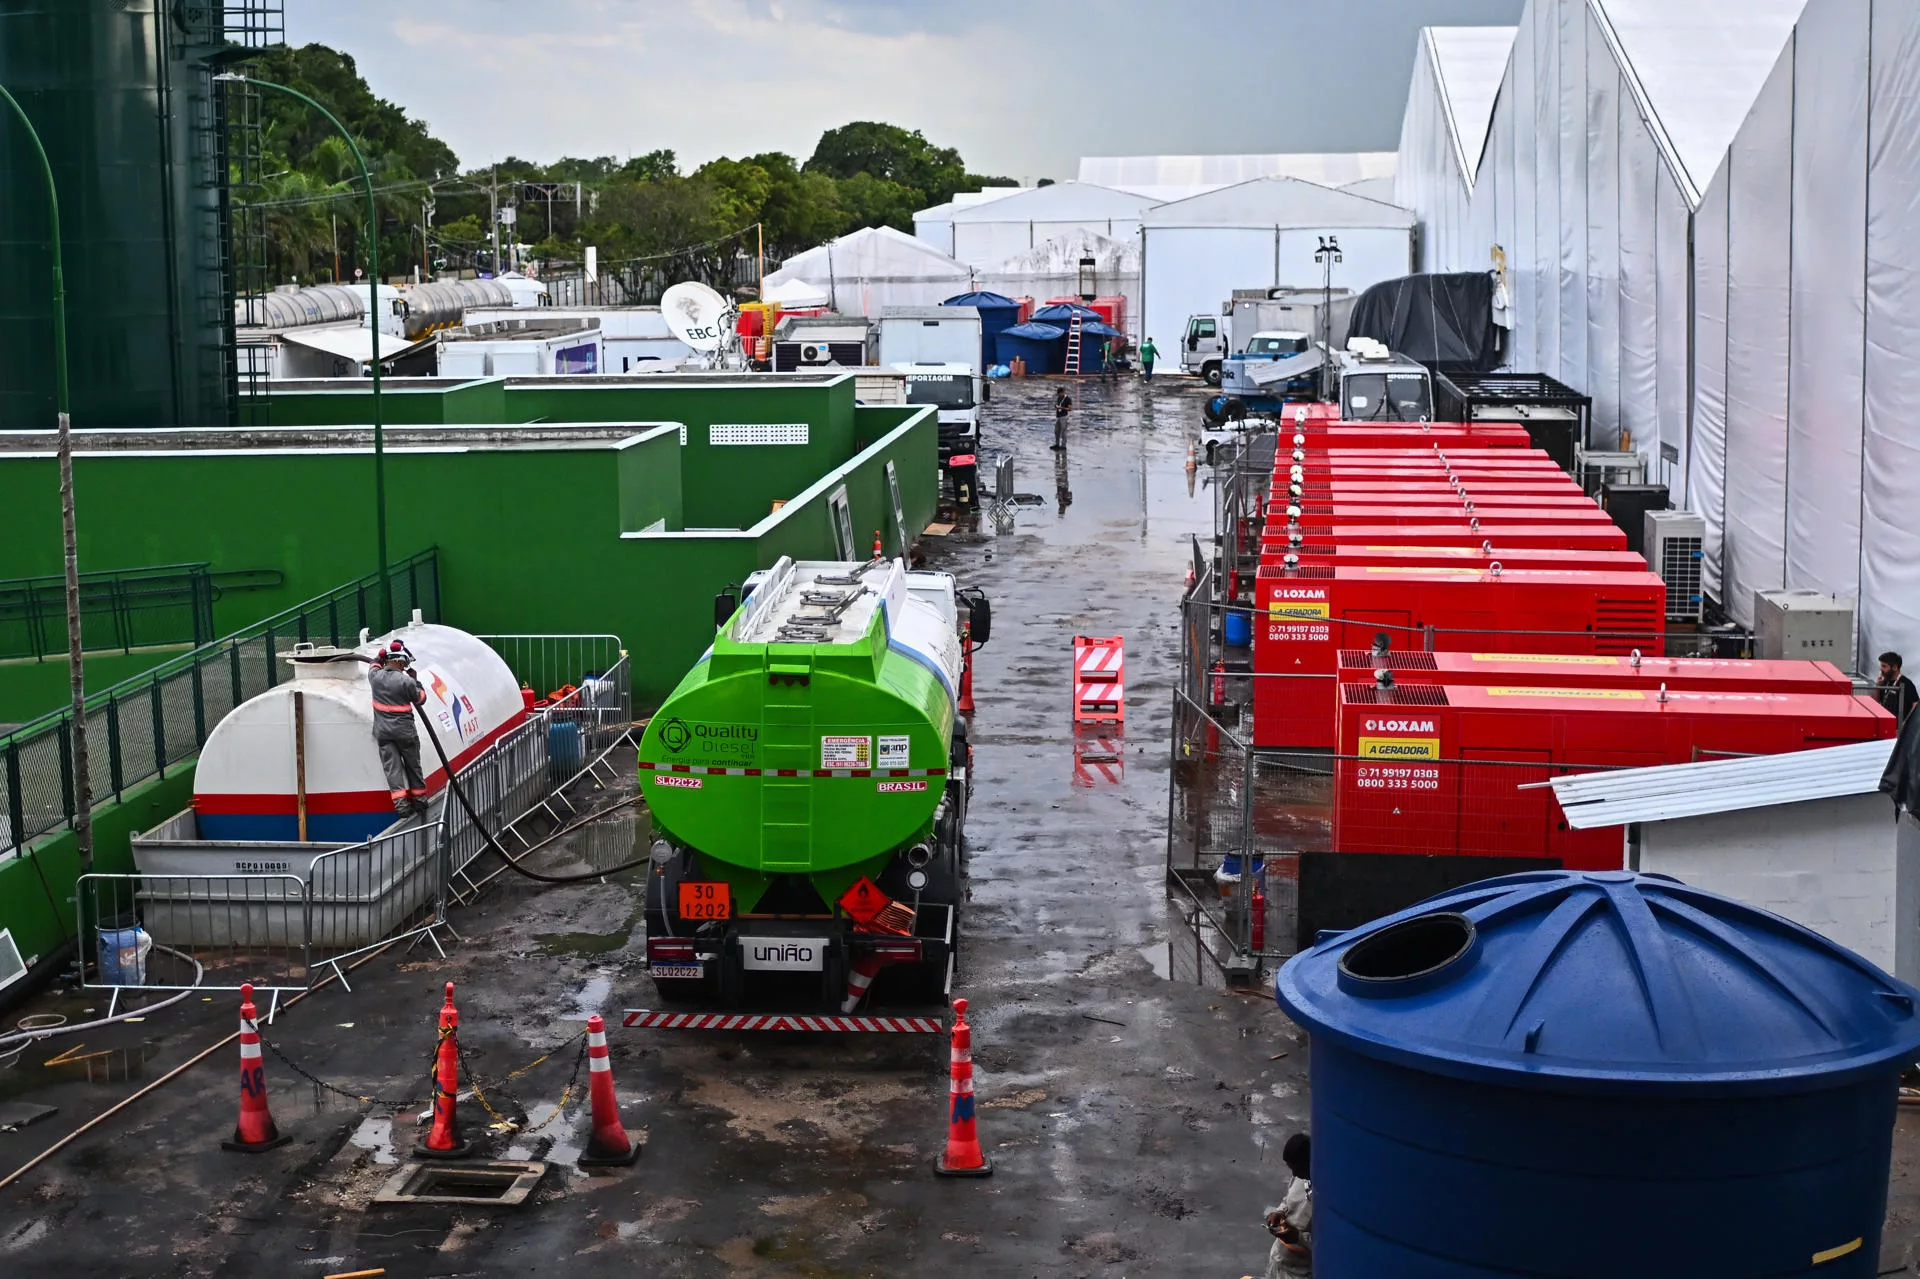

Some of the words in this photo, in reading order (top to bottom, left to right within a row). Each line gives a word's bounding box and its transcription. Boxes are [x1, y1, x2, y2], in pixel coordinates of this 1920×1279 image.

[686, 327, 717, 340] EBC
[1283, 589, 1325, 598] LOXAM
[1277, 625, 1286, 633] 71
[1286, 625, 1309, 633] 99197
[1310, 625, 1329, 633] 0303
[1269, 633, 1289, 641] 0800
[1291, 633, 1307, 641] 333
[1308, 633, 1329, 641] 5000
[1378, 719, 1434, 732] LOXAM
[695, 724, 758, 744] Quality
[702, 741, 754, 753] Diesel
[1369, 745, 1377, 754] A
[1379, 746, 1429, 754] GERADORA
[712, 759, 753, 767] continuar
[1369, 768, 1380, 777] 71
[1382, 768, 1411, 778] 99197
[1413, 769, 1439, 778] 0303
[656, 776, 701, 788] SLQ2C22
[879, 782, 925, 791] BRASIL
[1357, 779, 1385, 788] 0800
[1388, 780, 1408, 788] 333
[1411, 780, 1438, 789] 5000
[694, 885, 714, 899] 30
[686, 903, 726, 918] 1202
[656, 966, 698, 977] SLQ2C22
